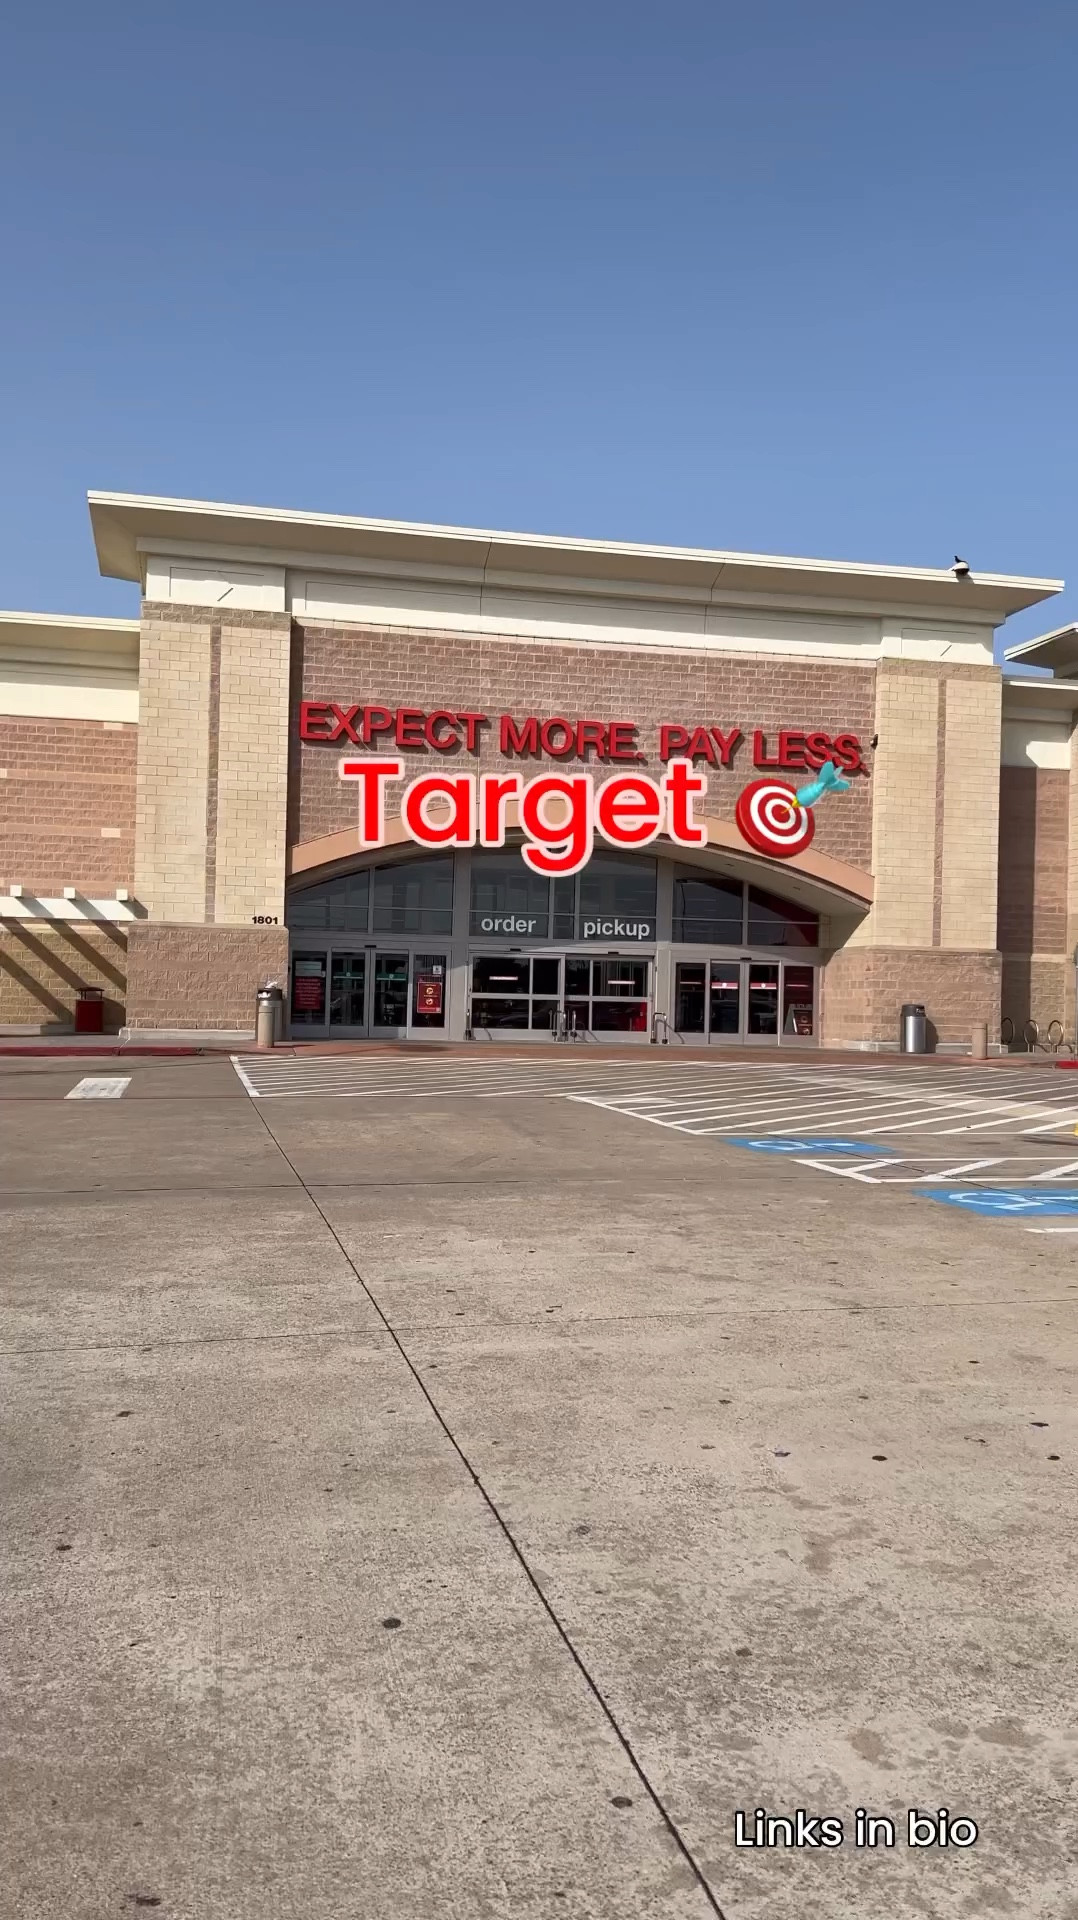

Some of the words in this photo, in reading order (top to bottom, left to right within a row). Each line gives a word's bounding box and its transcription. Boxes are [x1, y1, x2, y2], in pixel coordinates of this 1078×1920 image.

[299, 701, 488, 751] EXPECT
[499, 715, 645, 760] MORE.
[660, 724, 742, 765] PAY
[752, 728, 869, 772] LESS.
[251, 915, 279, 925] 1801
[480, 915, 537, 933] order
[583, 918, 651, 939] pickup
